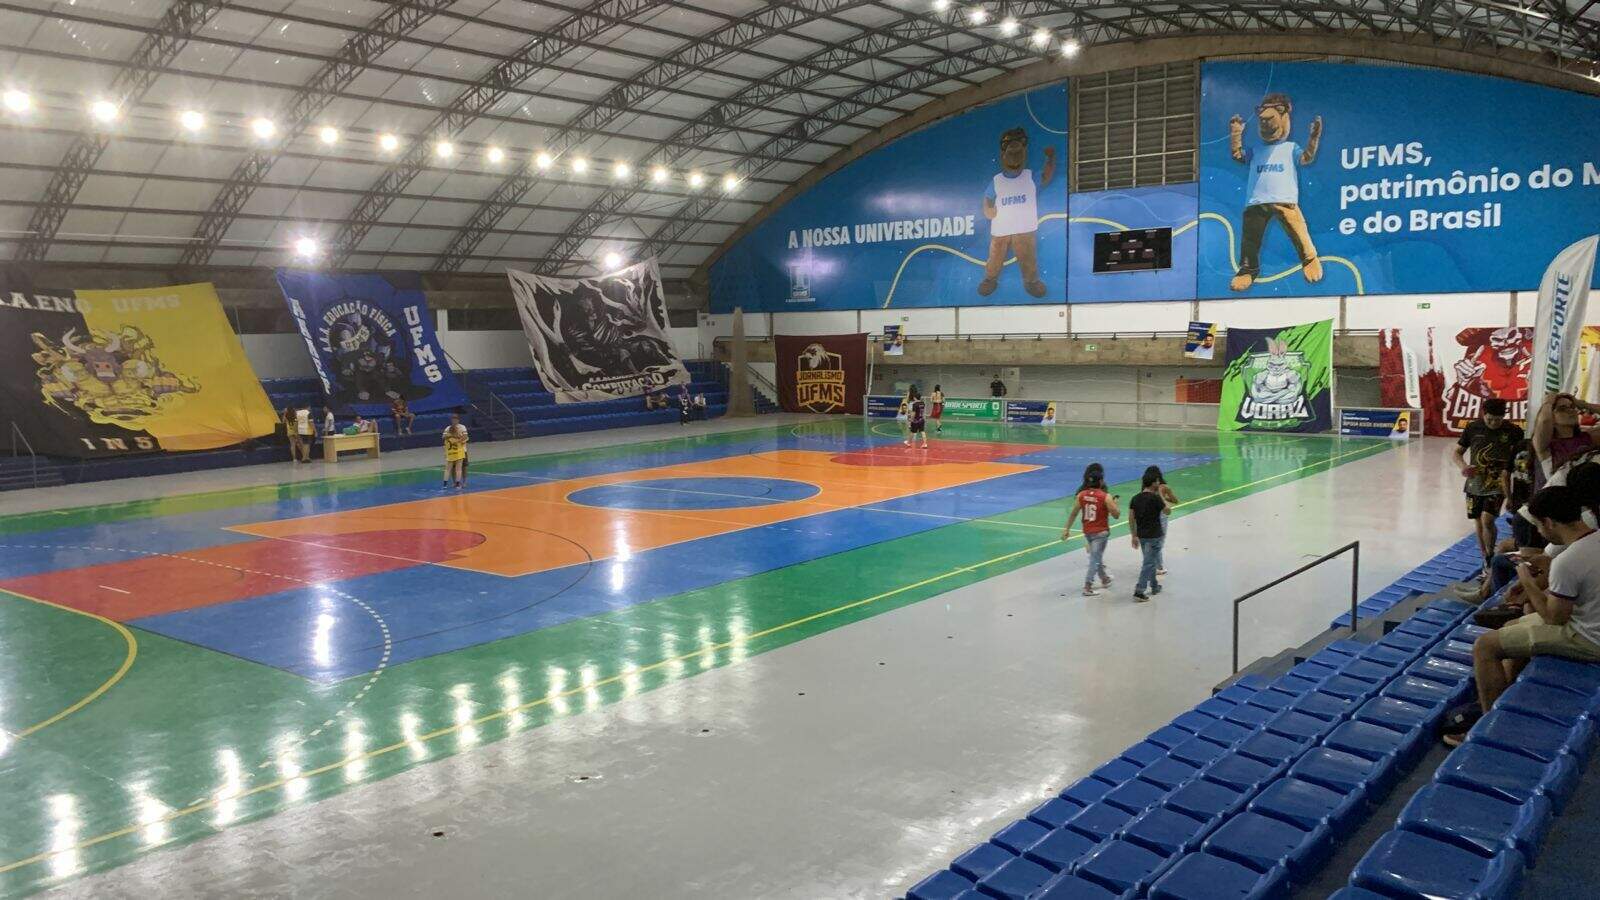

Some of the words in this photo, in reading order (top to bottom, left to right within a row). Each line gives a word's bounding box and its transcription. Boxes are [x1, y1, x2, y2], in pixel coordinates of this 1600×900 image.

[1257, 163, 1285, 173] UFMS
[1341, 142, 1432, 170] UFMS,
[1340, 166, 1521, 210] patrimônio
[1528, 163, 1574, 189] do
[1001, 194, 1027, 206] UFMS
[1339, 217, 1357, 235] e
[1363, 211, 1402, 234] do
[1409, 202, 1502, 232] Brasil
[788, 230, 799, 249] A
[802, 226, 851, 248] NOSSA
[854, 215, 975, 244] UNIVERSIDADE
[111, 294, 181, 313] UFMS
[323, 300, 368, 326] EDUCAÇÃO
[369, 308, 397, 338] FÍSICA
[403, 305, 443, 384] UFMS
[798, 371, 843, 381] JORNALISMO
[798, 383, 844, 404] UFMS
[1084, 503, 1097, 522] 16
